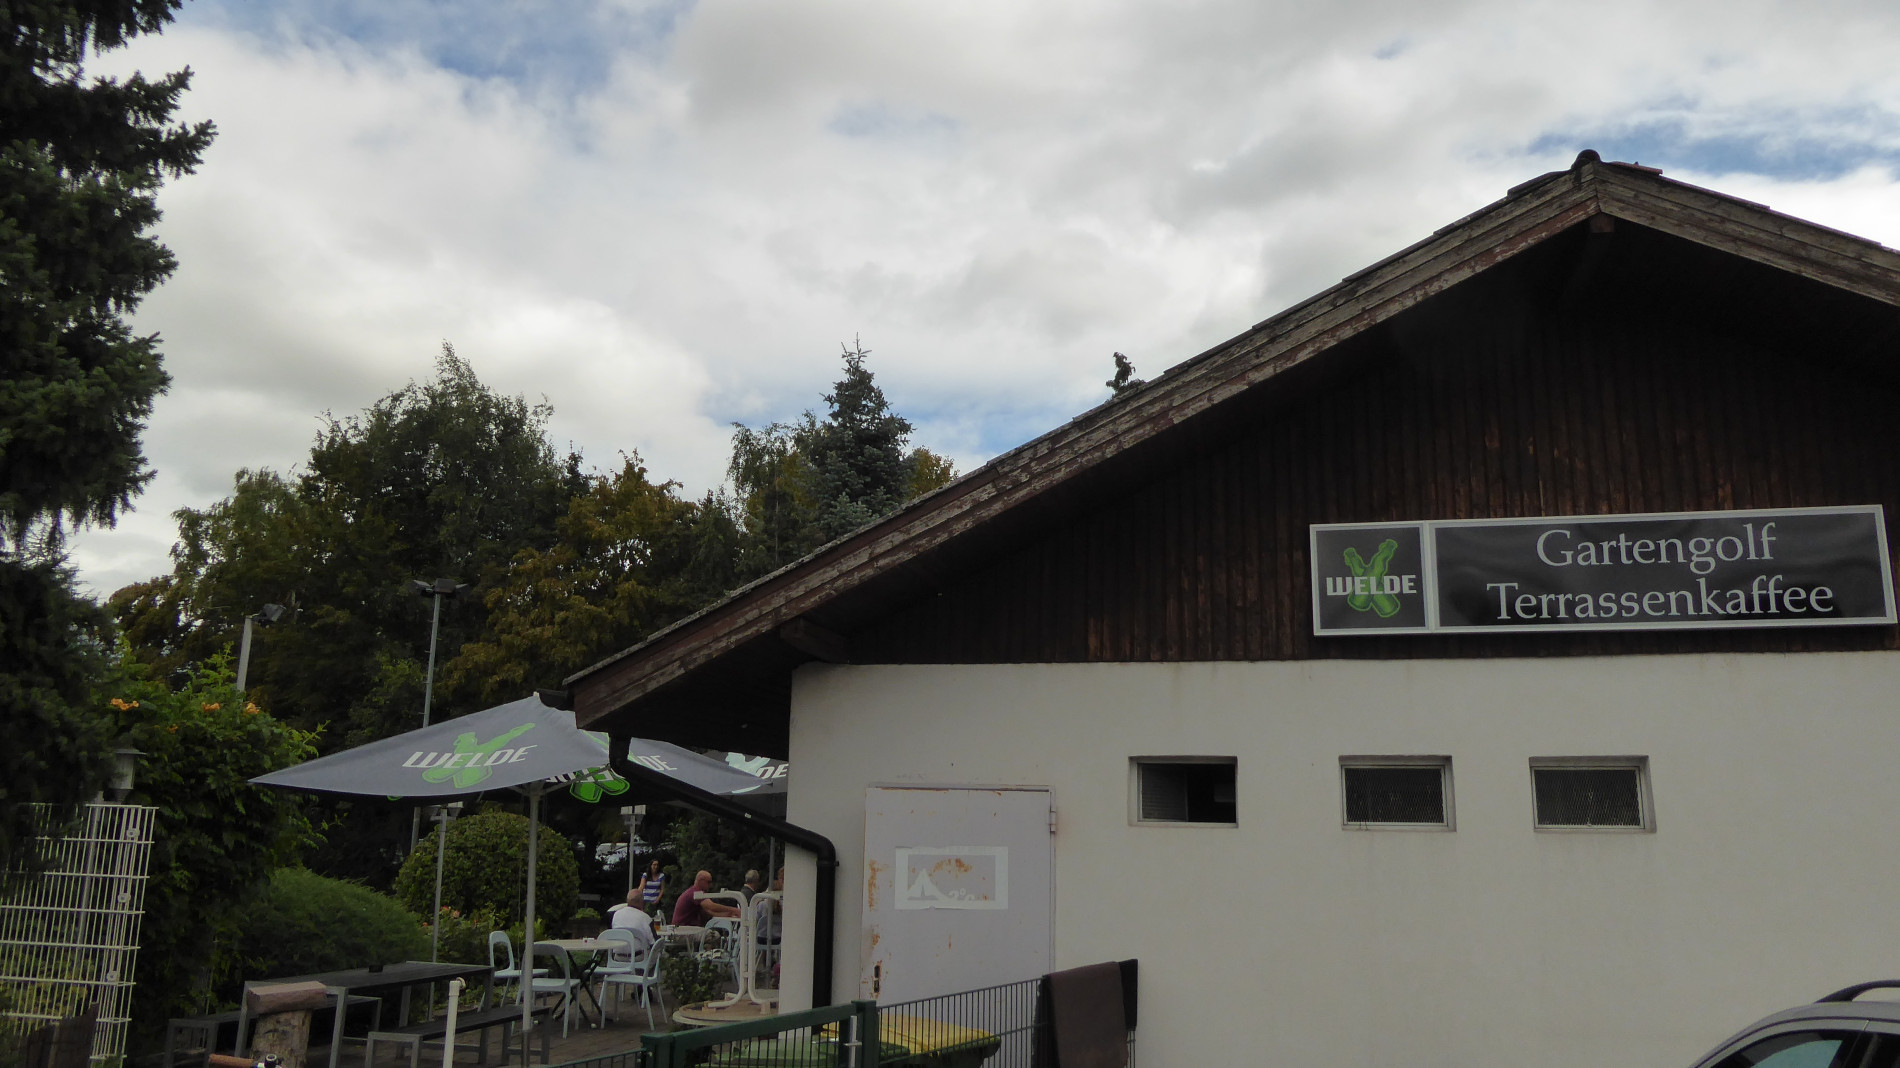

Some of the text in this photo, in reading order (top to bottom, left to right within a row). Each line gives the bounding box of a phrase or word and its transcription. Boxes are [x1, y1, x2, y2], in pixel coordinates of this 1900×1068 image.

[1536, 522, 1776, 574] Gartengolf
[1326, 575, 1417, 596] WELDE
[1486, 574, 1834, 619] Terrassenkaffee
[402, 745, 538, 768] WELDE
